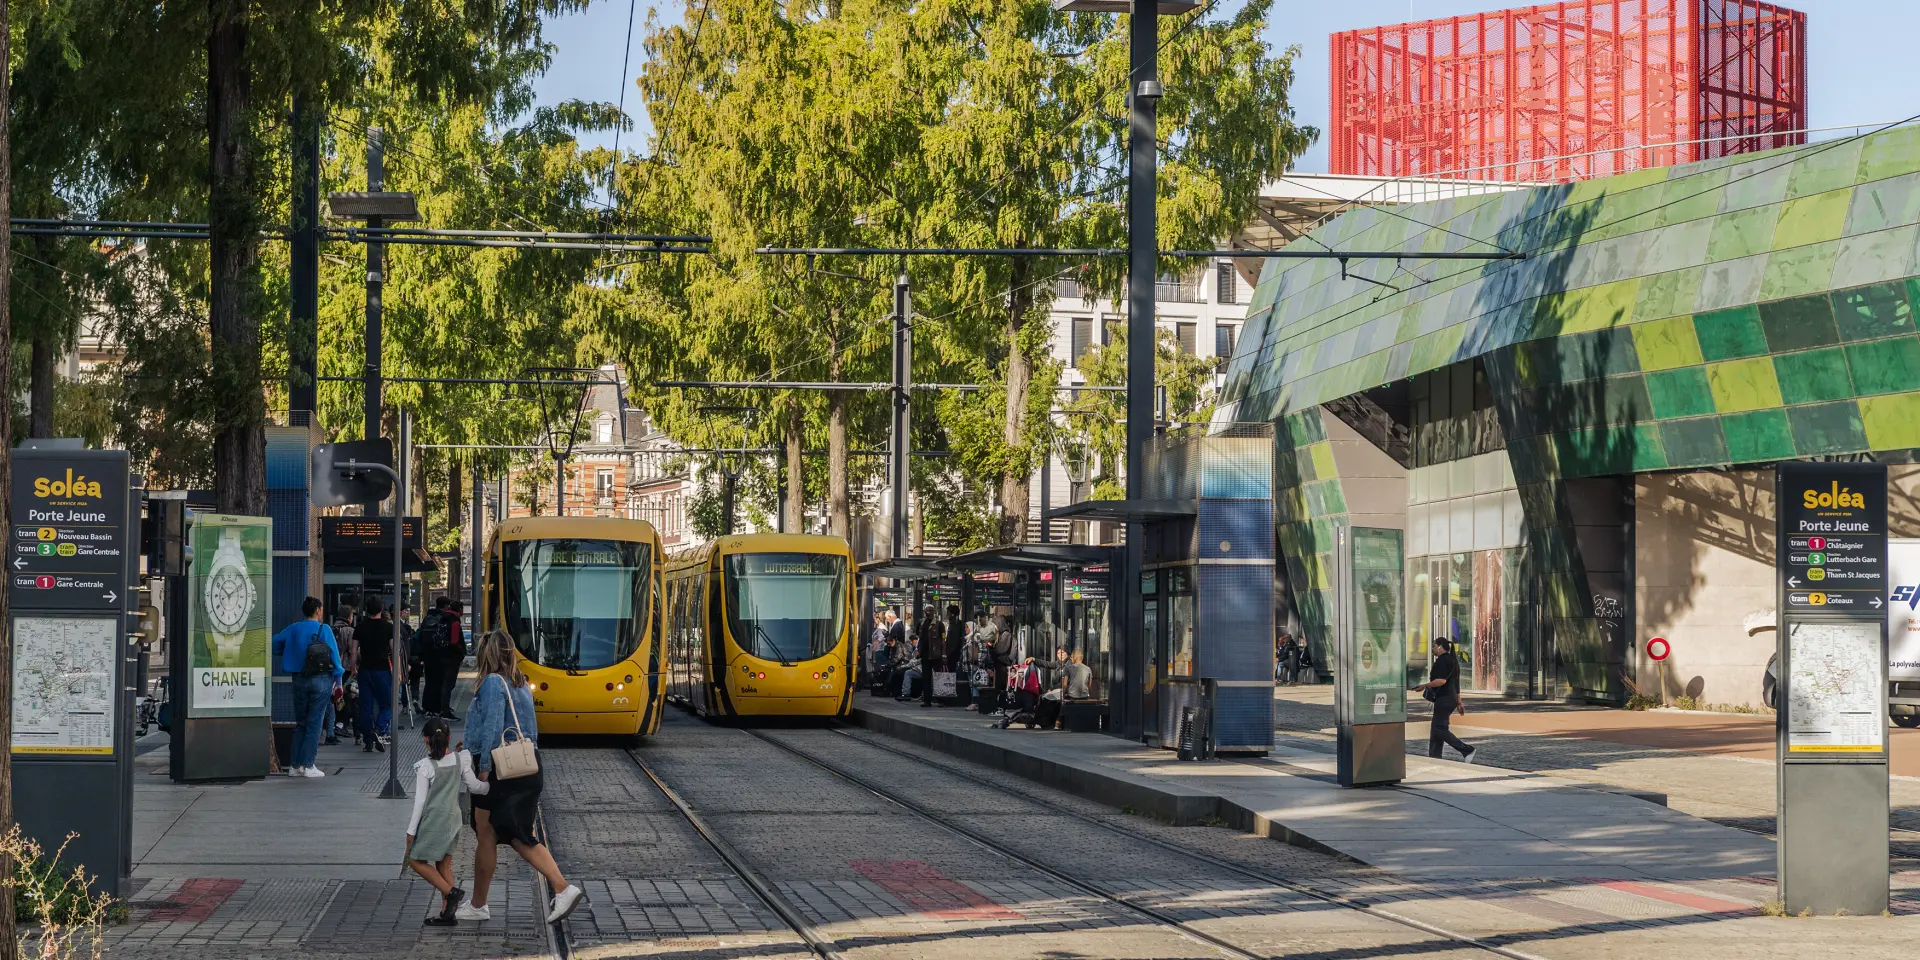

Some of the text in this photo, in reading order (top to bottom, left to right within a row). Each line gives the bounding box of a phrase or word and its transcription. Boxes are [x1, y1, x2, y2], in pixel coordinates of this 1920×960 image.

[34, 468, 102, 499] Soléa
[1803, 481, 1865, 510] Soléa
[30, 510, 106, 522] Porte Jeune
[1800, 520, 1869, 532] Porte Jeune
[18, 529, 50, 539] tram 2
[90, 532, 112, 541] Bassin
[1814, 539, 1819, 548] 1
[1827, 543, 1864, 551] Châtaignier
[17, 544, 50, 554] tram 3
[572, 551, 616, 564] CENTRALE
[1813, 554, 1820, 564] 3
[765, 563, 812, 573] LUTTERBACH
[1827, 571, 1880, 580] Thann St Jacques
[16, 577, 48, 587] tram 1
[1814, 595, 1821, 604] 2
[201, 671, 256, 687] CHANEL
